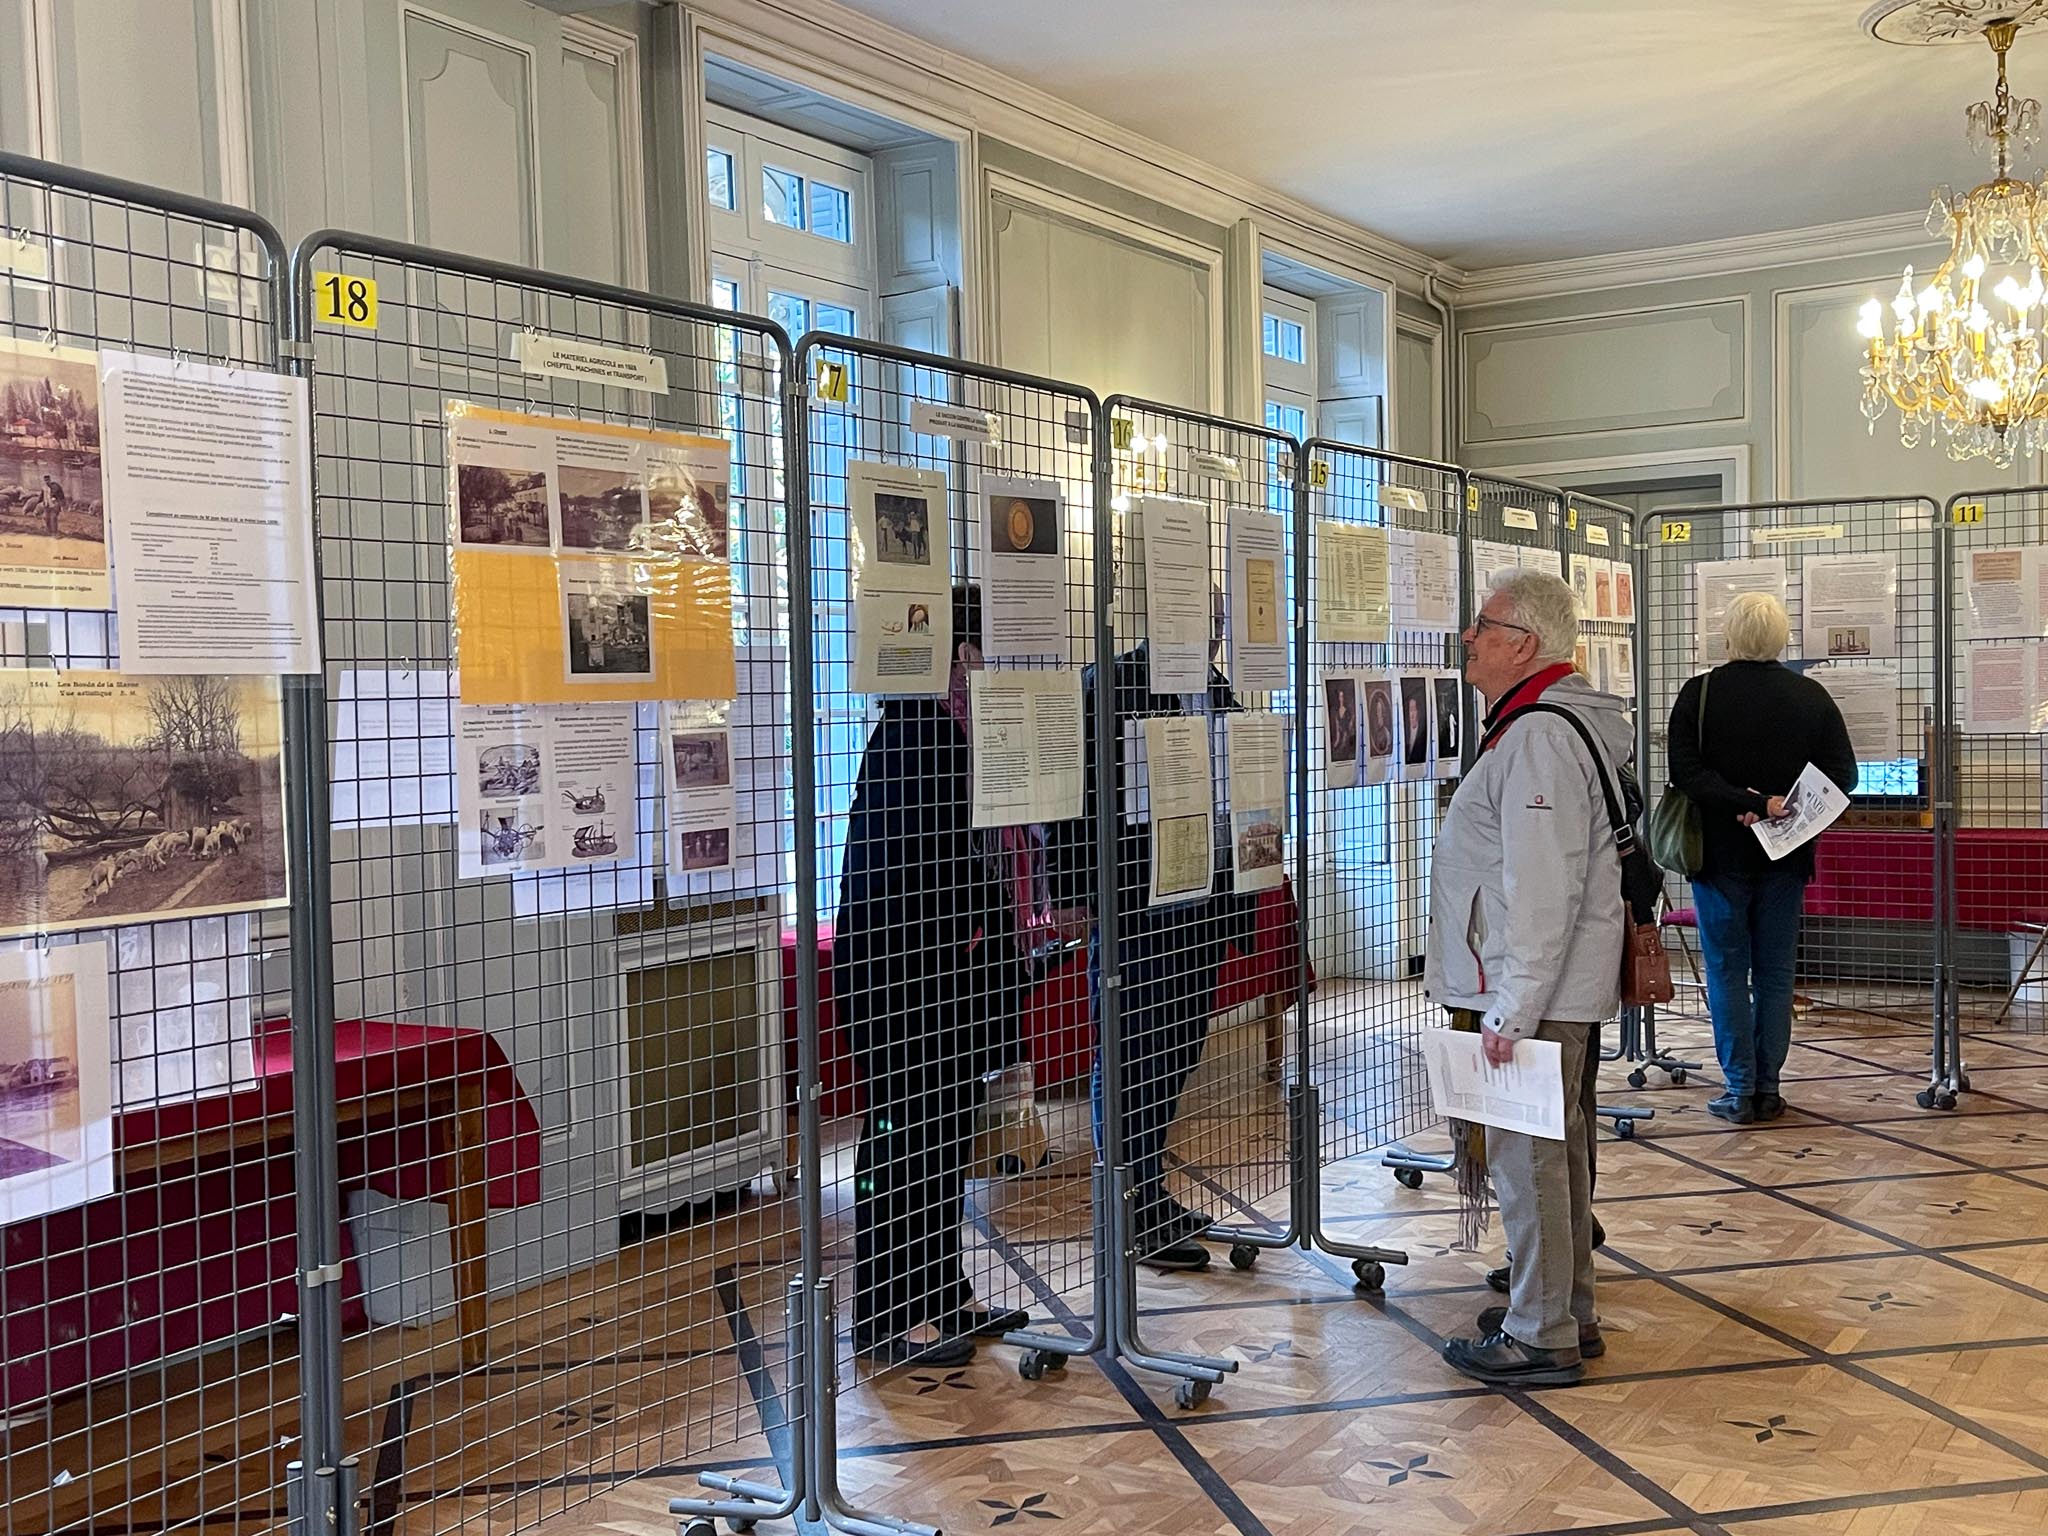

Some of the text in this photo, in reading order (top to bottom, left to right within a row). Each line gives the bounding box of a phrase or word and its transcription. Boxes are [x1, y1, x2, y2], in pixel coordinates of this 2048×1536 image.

[325, 277, 369, 321] 18
[589, 357, 616, 368] AGRICOLE
[575, 365, 606, 376] MACHINES
[613, 371, 644, 382] TRANSPORT
[1115, 420, 1132, 447] 16
[1312, 462, 1326, 485] 15
[1468, 487, 1476, 507] 14
[1958, 506, 1979, 523] 11
[1666, 523, 1685, 540] 12
